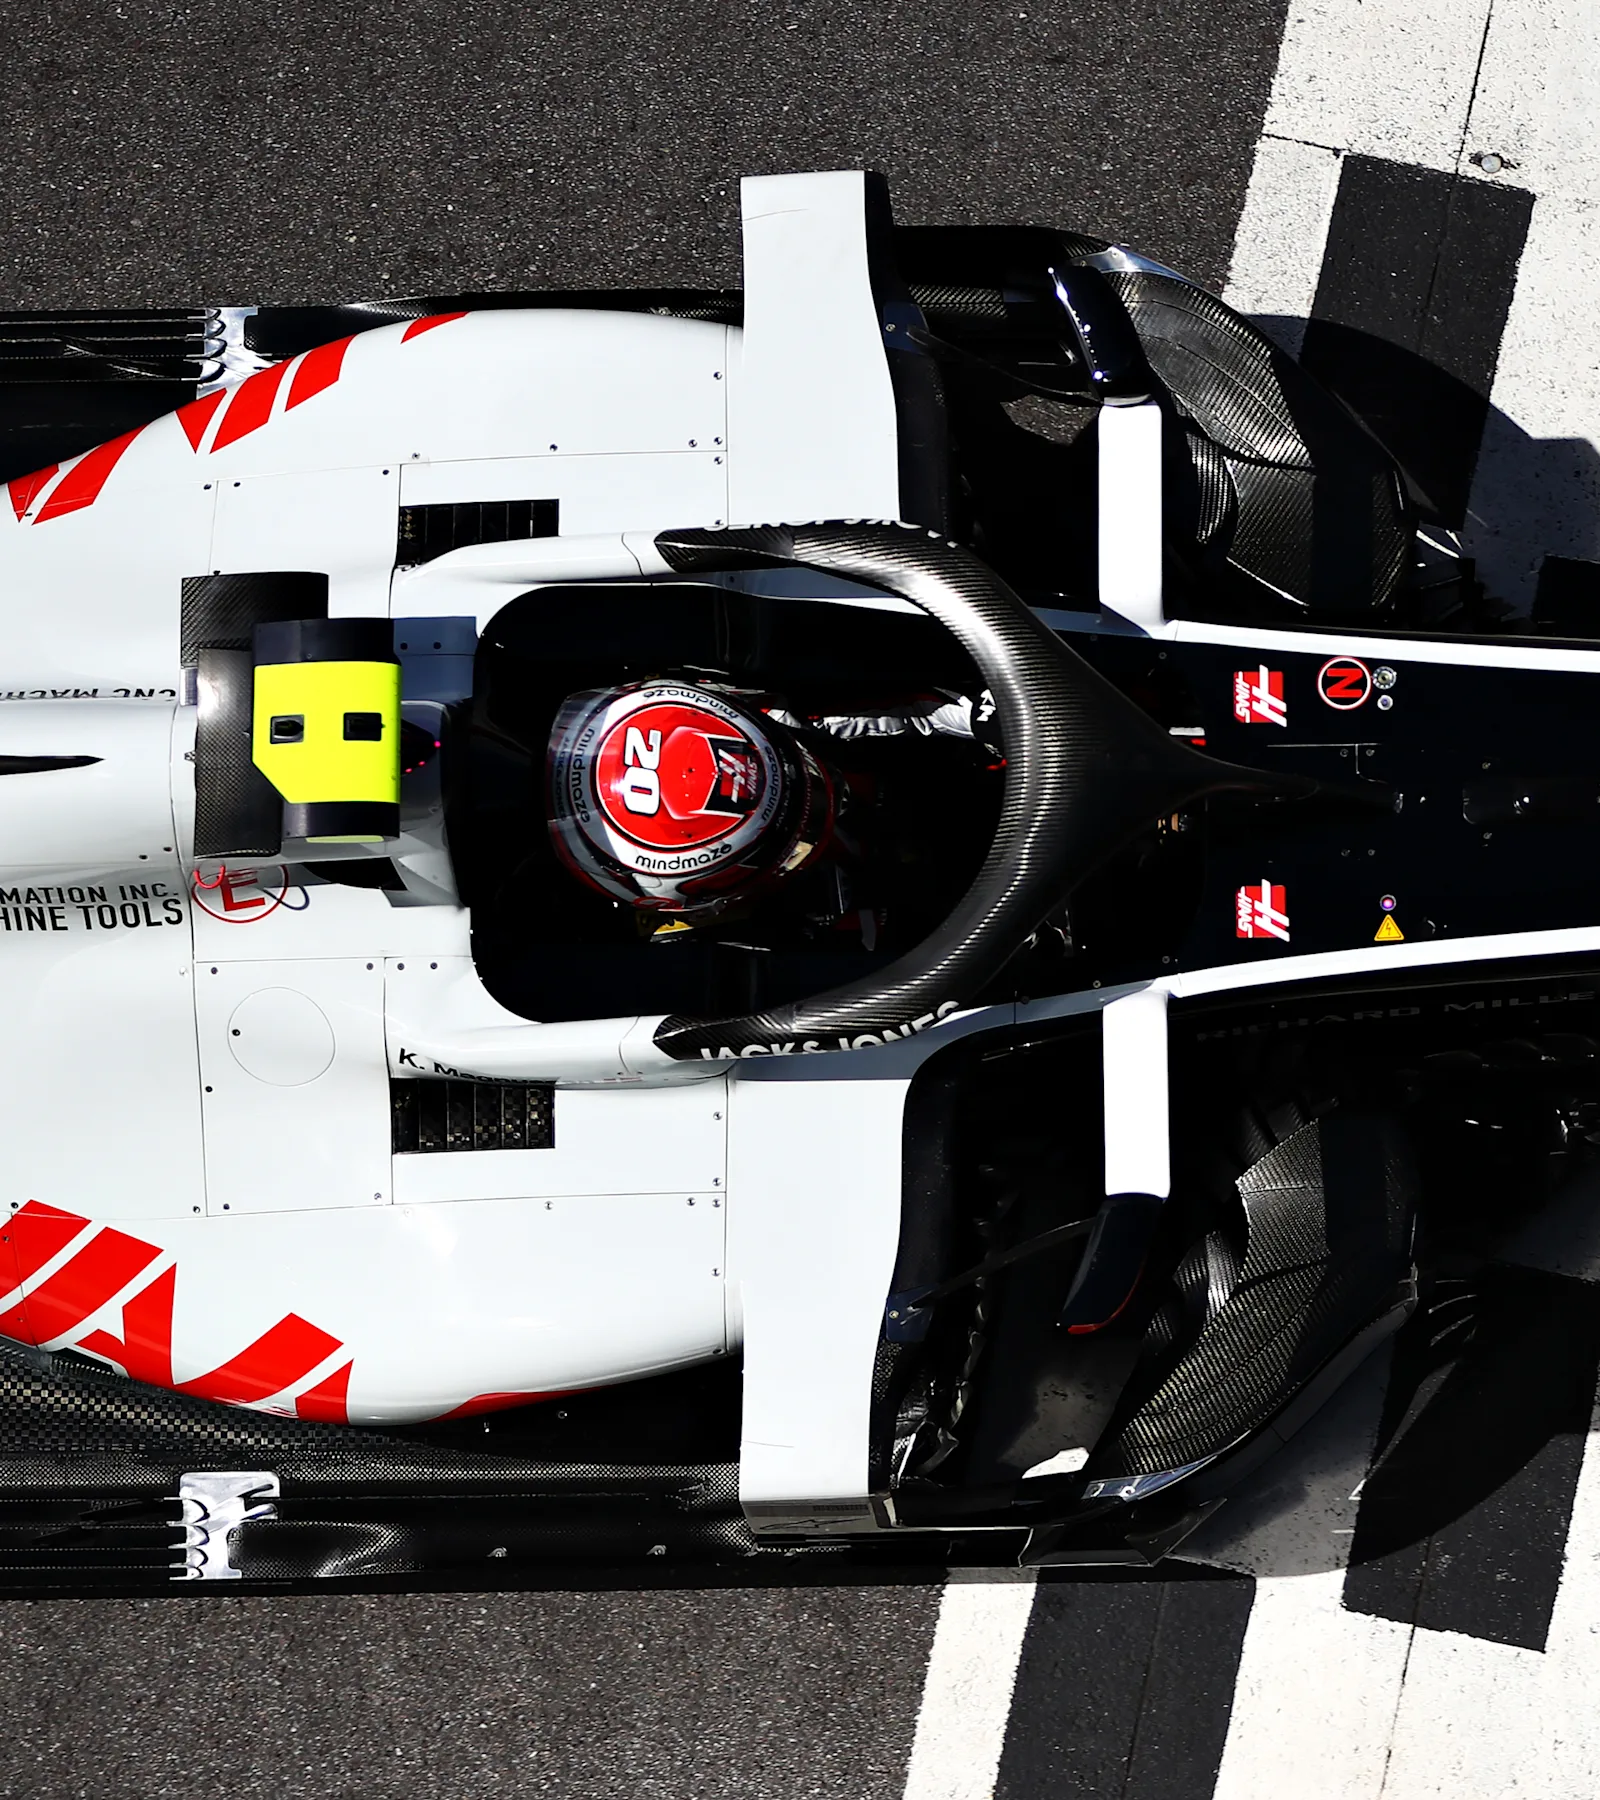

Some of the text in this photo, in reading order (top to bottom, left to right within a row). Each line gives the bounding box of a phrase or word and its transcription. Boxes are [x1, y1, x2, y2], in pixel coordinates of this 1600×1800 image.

[644, 689, 740, 719] mindmaze
[572, 728, 595, 822] mindmaze
[624, 726, 662, 816] 20
[761, 745, 781, 822] mindmaze
[635, 844, 733, 870] mindmaze
[119, 882, 179, 901] INC.
[76, 898, 183, 930] TOOLS
[1196, 990, 1596, 1041] RICHARD MILLE
[398, 1047, 425, 1070] K.
